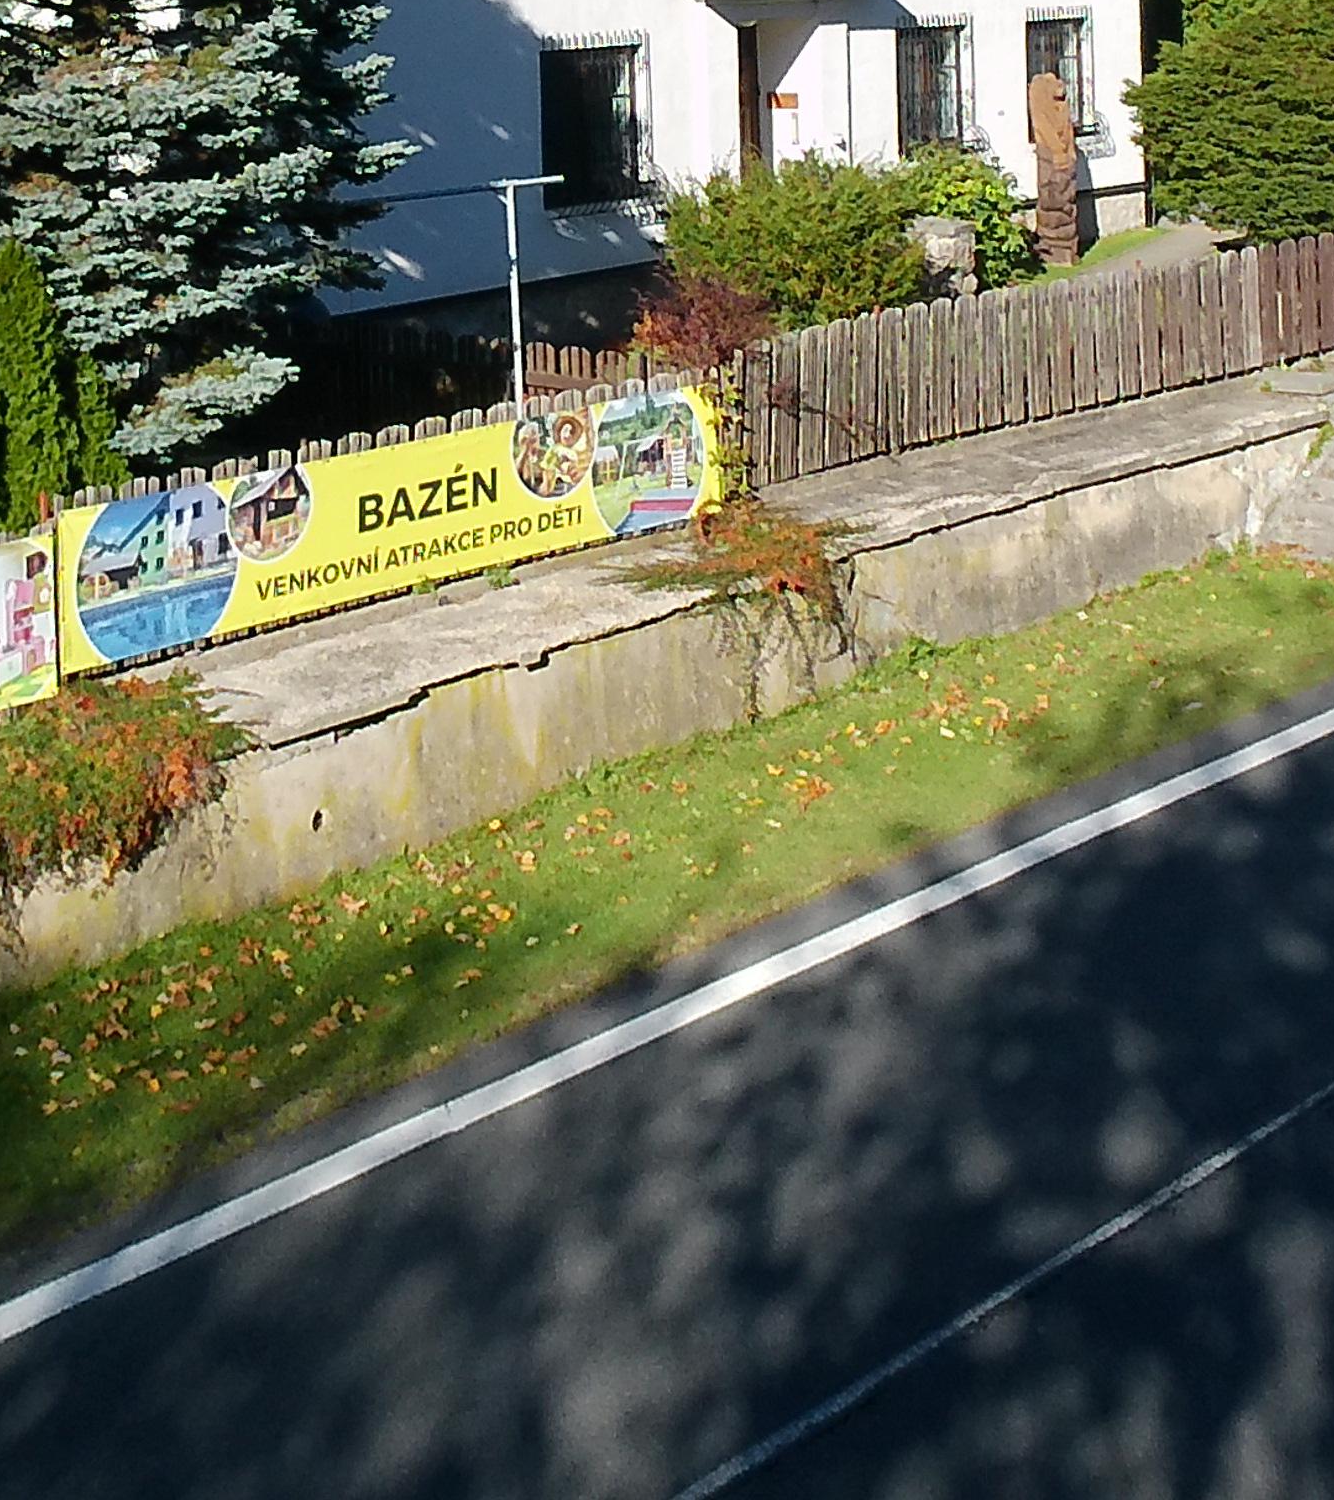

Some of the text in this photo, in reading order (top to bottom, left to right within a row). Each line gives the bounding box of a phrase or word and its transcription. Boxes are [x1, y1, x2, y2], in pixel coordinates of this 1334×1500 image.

[357, 464, 499, 534] BAZÉN
[255, 546, 381, 601] VENKOVNÍ
[385, 527, 485, 570] ATRAKCE
[490, 518, 533, 546] PRO
